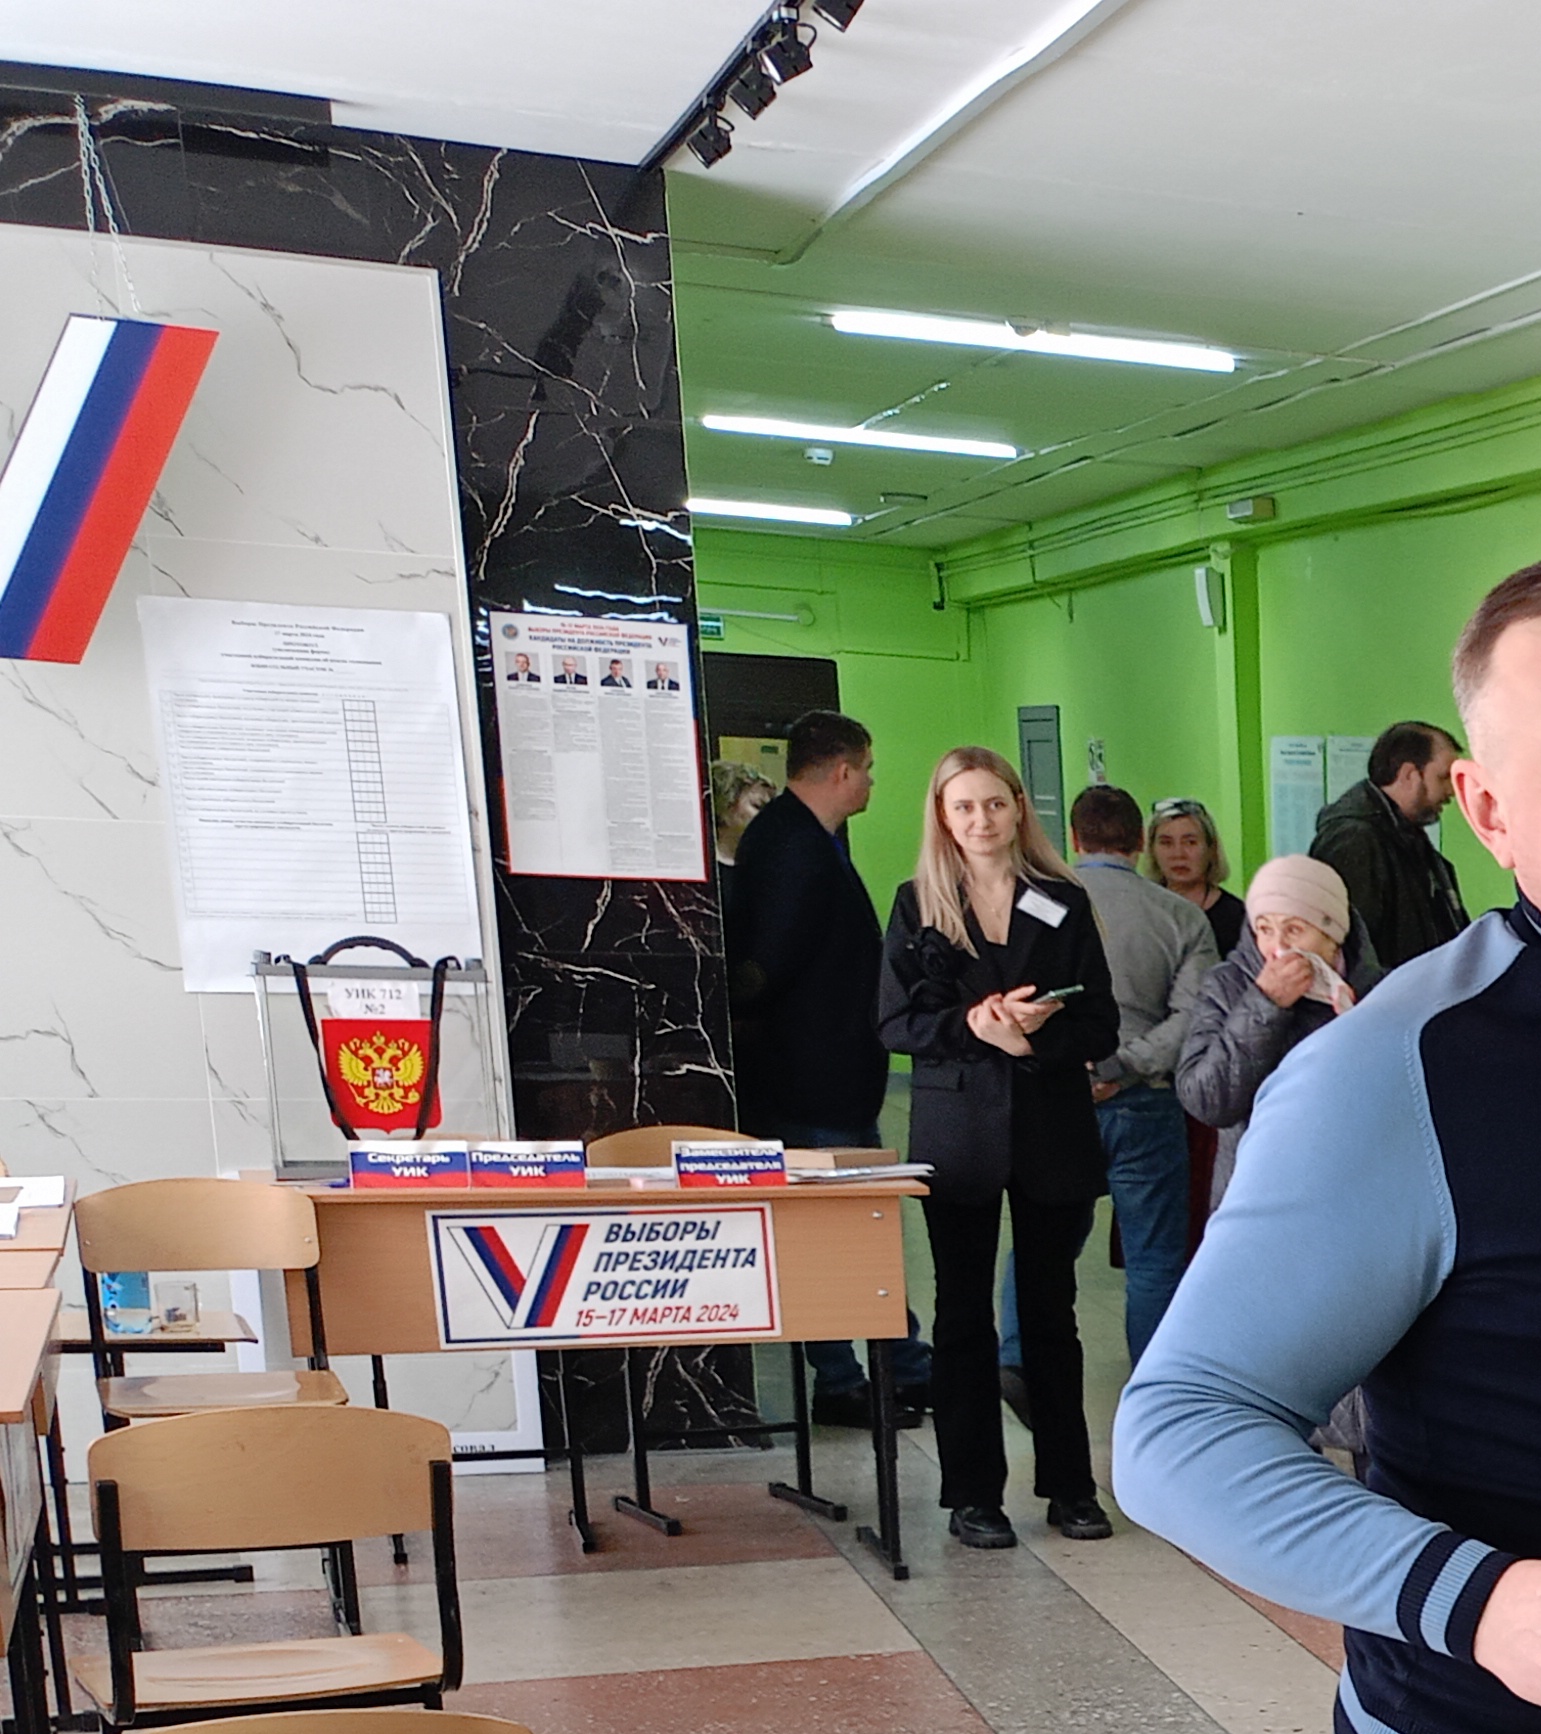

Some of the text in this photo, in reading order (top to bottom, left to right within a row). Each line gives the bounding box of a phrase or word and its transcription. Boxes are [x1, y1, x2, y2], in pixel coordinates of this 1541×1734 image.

[345, 987, 402, 1000] УИК 712
[367, 1152, 451, 1164] Секретарь
[471, 1152, 581, 1164] Председатель
[391, 1166, 430, 1178] УИК
[509, 1165, 546, 1178] УИК
[715, 1173, 752, 1185] УИК
[603, 1219, 721, 1244] ВЫБОРЫ
[592, 1247, 758, 1273] ПРЕЗИДЕНТА
[582, 1278, 690, 1301] РОССИИ
[629, 1305, 692, 1325] МАРТА
[695, 1303, 740, 1323] 2024
